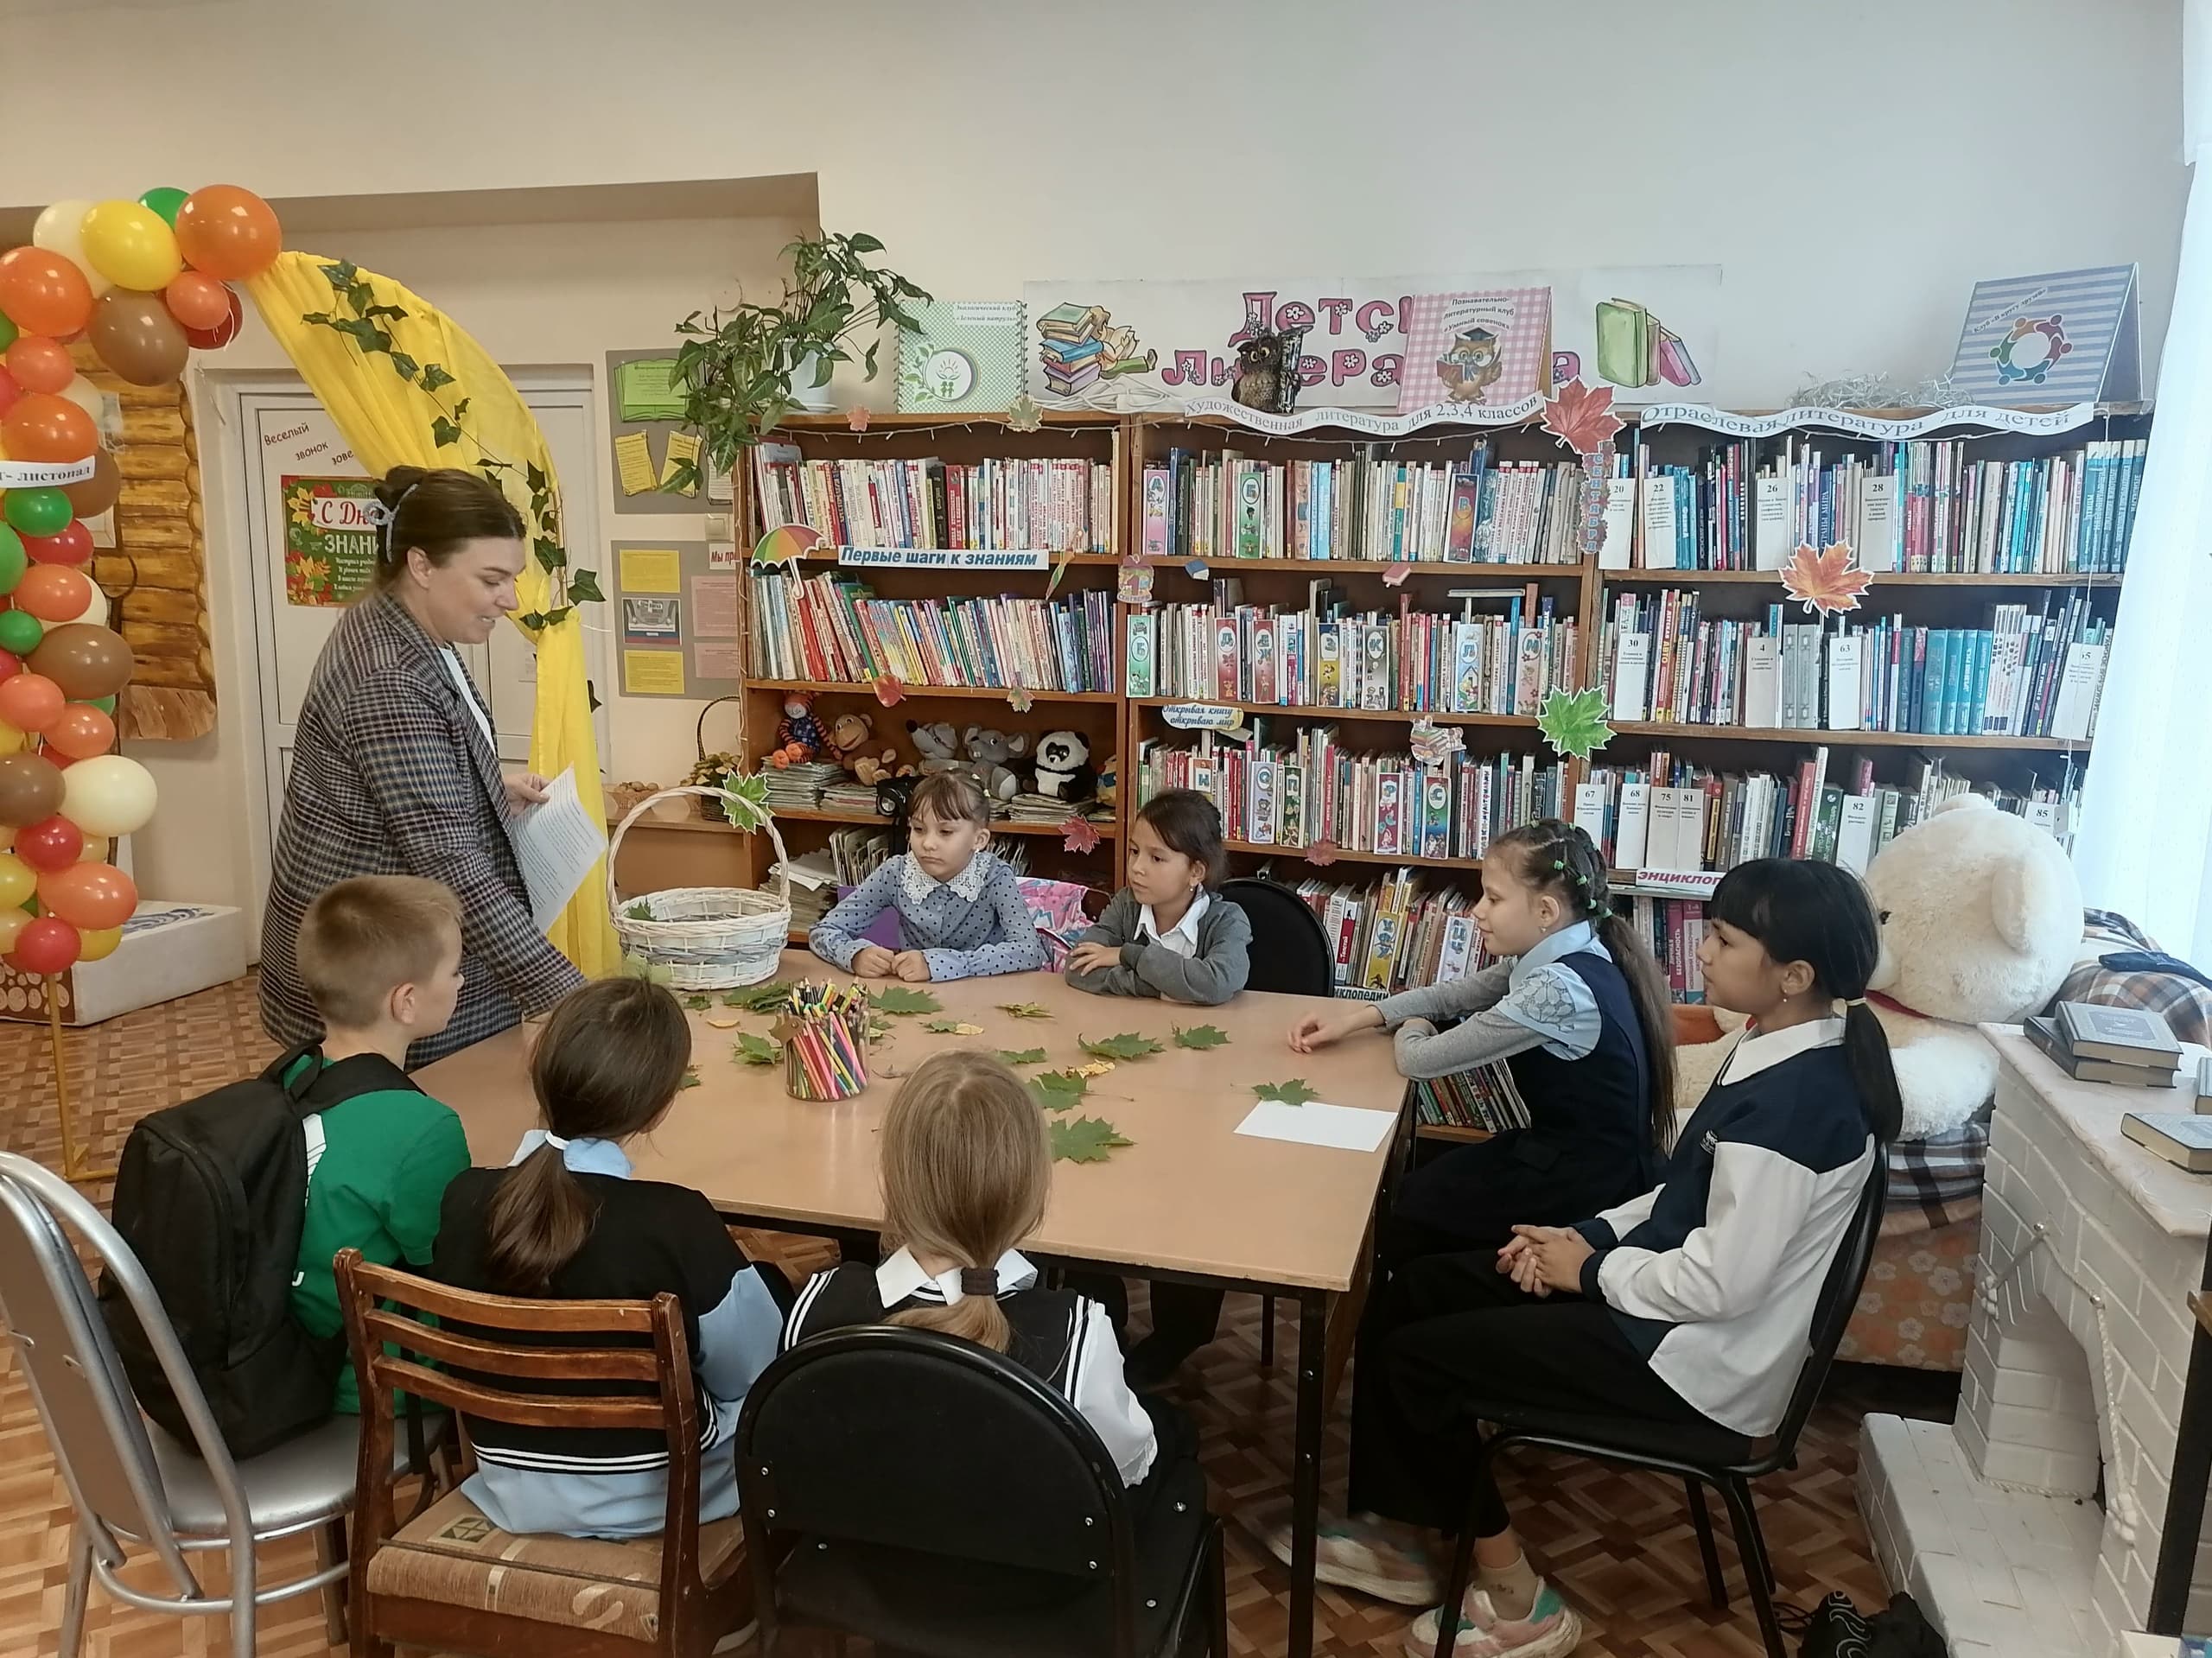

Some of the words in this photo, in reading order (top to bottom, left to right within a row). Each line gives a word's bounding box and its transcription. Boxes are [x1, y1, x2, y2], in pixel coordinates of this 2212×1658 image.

[1444, 306, 1497, 320] литературный
[1497, 308, 1515, 316] клуб
[1185, 398, 1303, 431] Художественная
[1315, 411, 1400, 434] литература
[1408, 409, 1432, 431] для
[1436, 403, 1473, 418] 2,3,4
[1478, 395, 1537, 419] классов
[1783, 409, 1923, 437] литература
[1941, 409, 1987, 423] для
[1995, 412, 2070, 427] детей
[264, 422, 310, 446] Веселый
[295, 441, 329, 461] звонок
[331, 450, 354, 466] зове
[1613, 485, 1624, 493] 20
[1653, 484, 1664, 492] 22
[1766, 485, 1778, 493] 26
[1872, 484, 1884, 492] 28
[321, 501, 334, 524] С
[324, 534, 378, 555] ЗНАНИ
[725, 549, 734, 565] пр
[841, 546, 902, 565] Первые
[906, 550, 947, 565] шаги
[950, 553, 961, 565] к
[964, 553, 1038, 567] знаниям
[1628, 639, 1639, 648] 30
[1662, 640, 1670, 664] АВТО
[1162, 703, 1205, 716] Открывая
[1208, 707, 1233, 718] книгу
[1170, 716, 1214, 727] открываю
[1216, 719, 1235, 729] мир
[1853, 802, 1865, 810] 82
[2037, 809, 2048, 817] 85
[1637, 871, 1722, 886] ЭНЦИКЛОП
